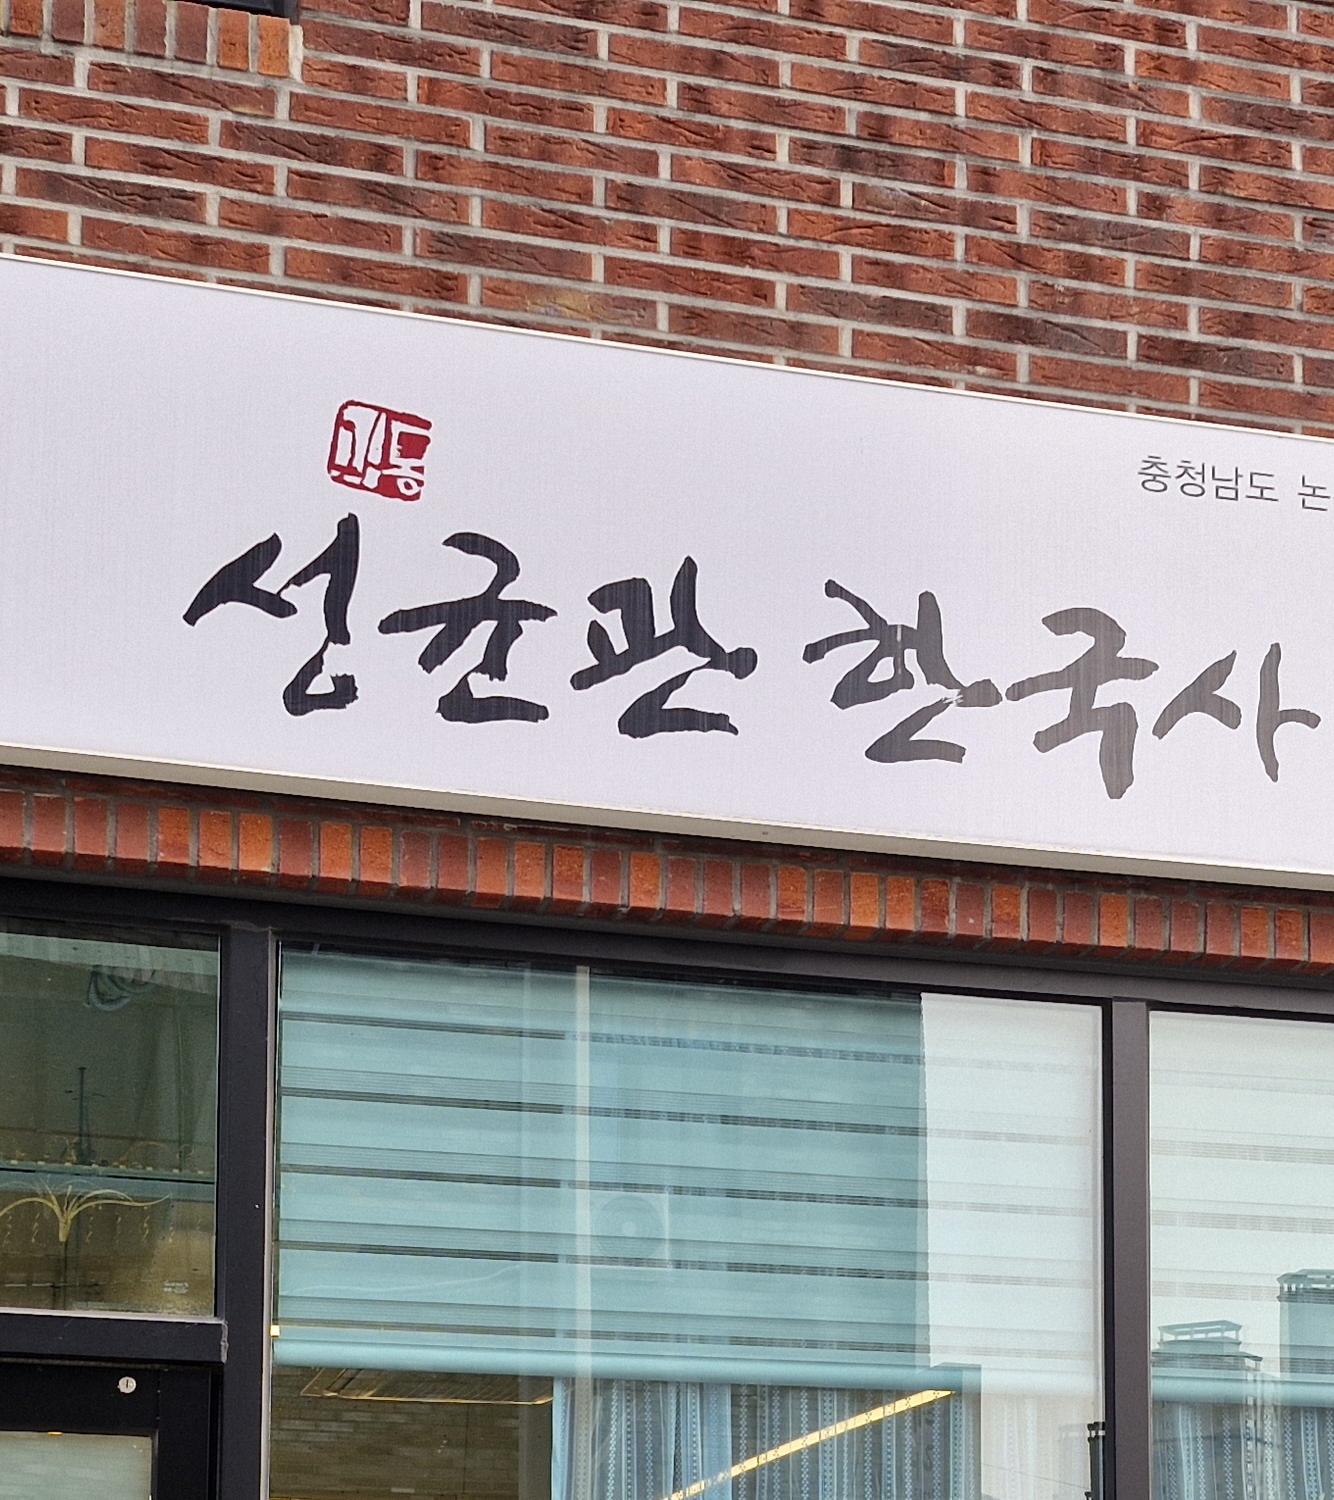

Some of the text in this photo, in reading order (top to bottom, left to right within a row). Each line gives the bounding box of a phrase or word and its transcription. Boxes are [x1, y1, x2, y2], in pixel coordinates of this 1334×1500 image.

[1136, 453, 1279, 506] 충청남도
[183, 511, 759, 740] 성균관
[802, 579, 1321, 800] 한국사
